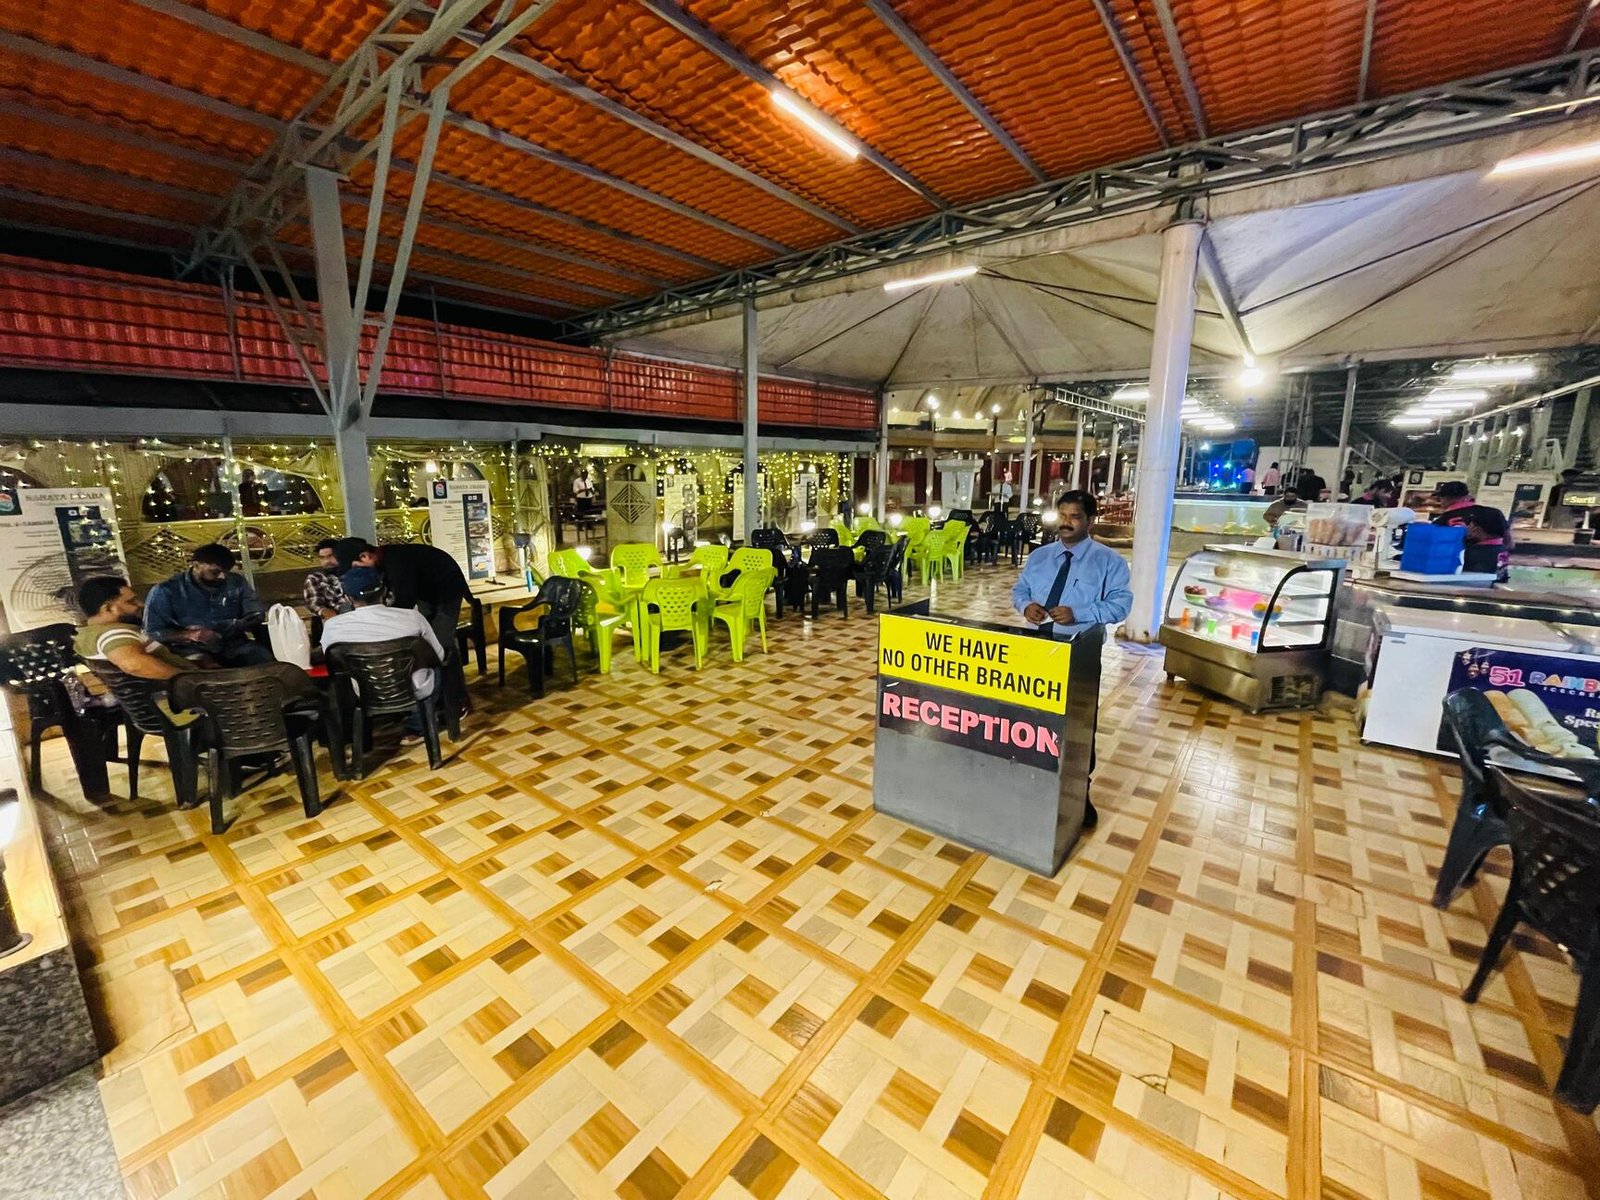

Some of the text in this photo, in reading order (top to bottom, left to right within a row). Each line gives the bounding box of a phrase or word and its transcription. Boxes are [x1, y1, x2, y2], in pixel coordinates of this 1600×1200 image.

[925, 631, 1010, 664] WE HAVE
[882, 648, 1062, 702] NO OTHER BRANCH
[1488, 665, 1526, 687] 51
[882, 691, 1060, 758] RECEPTION
